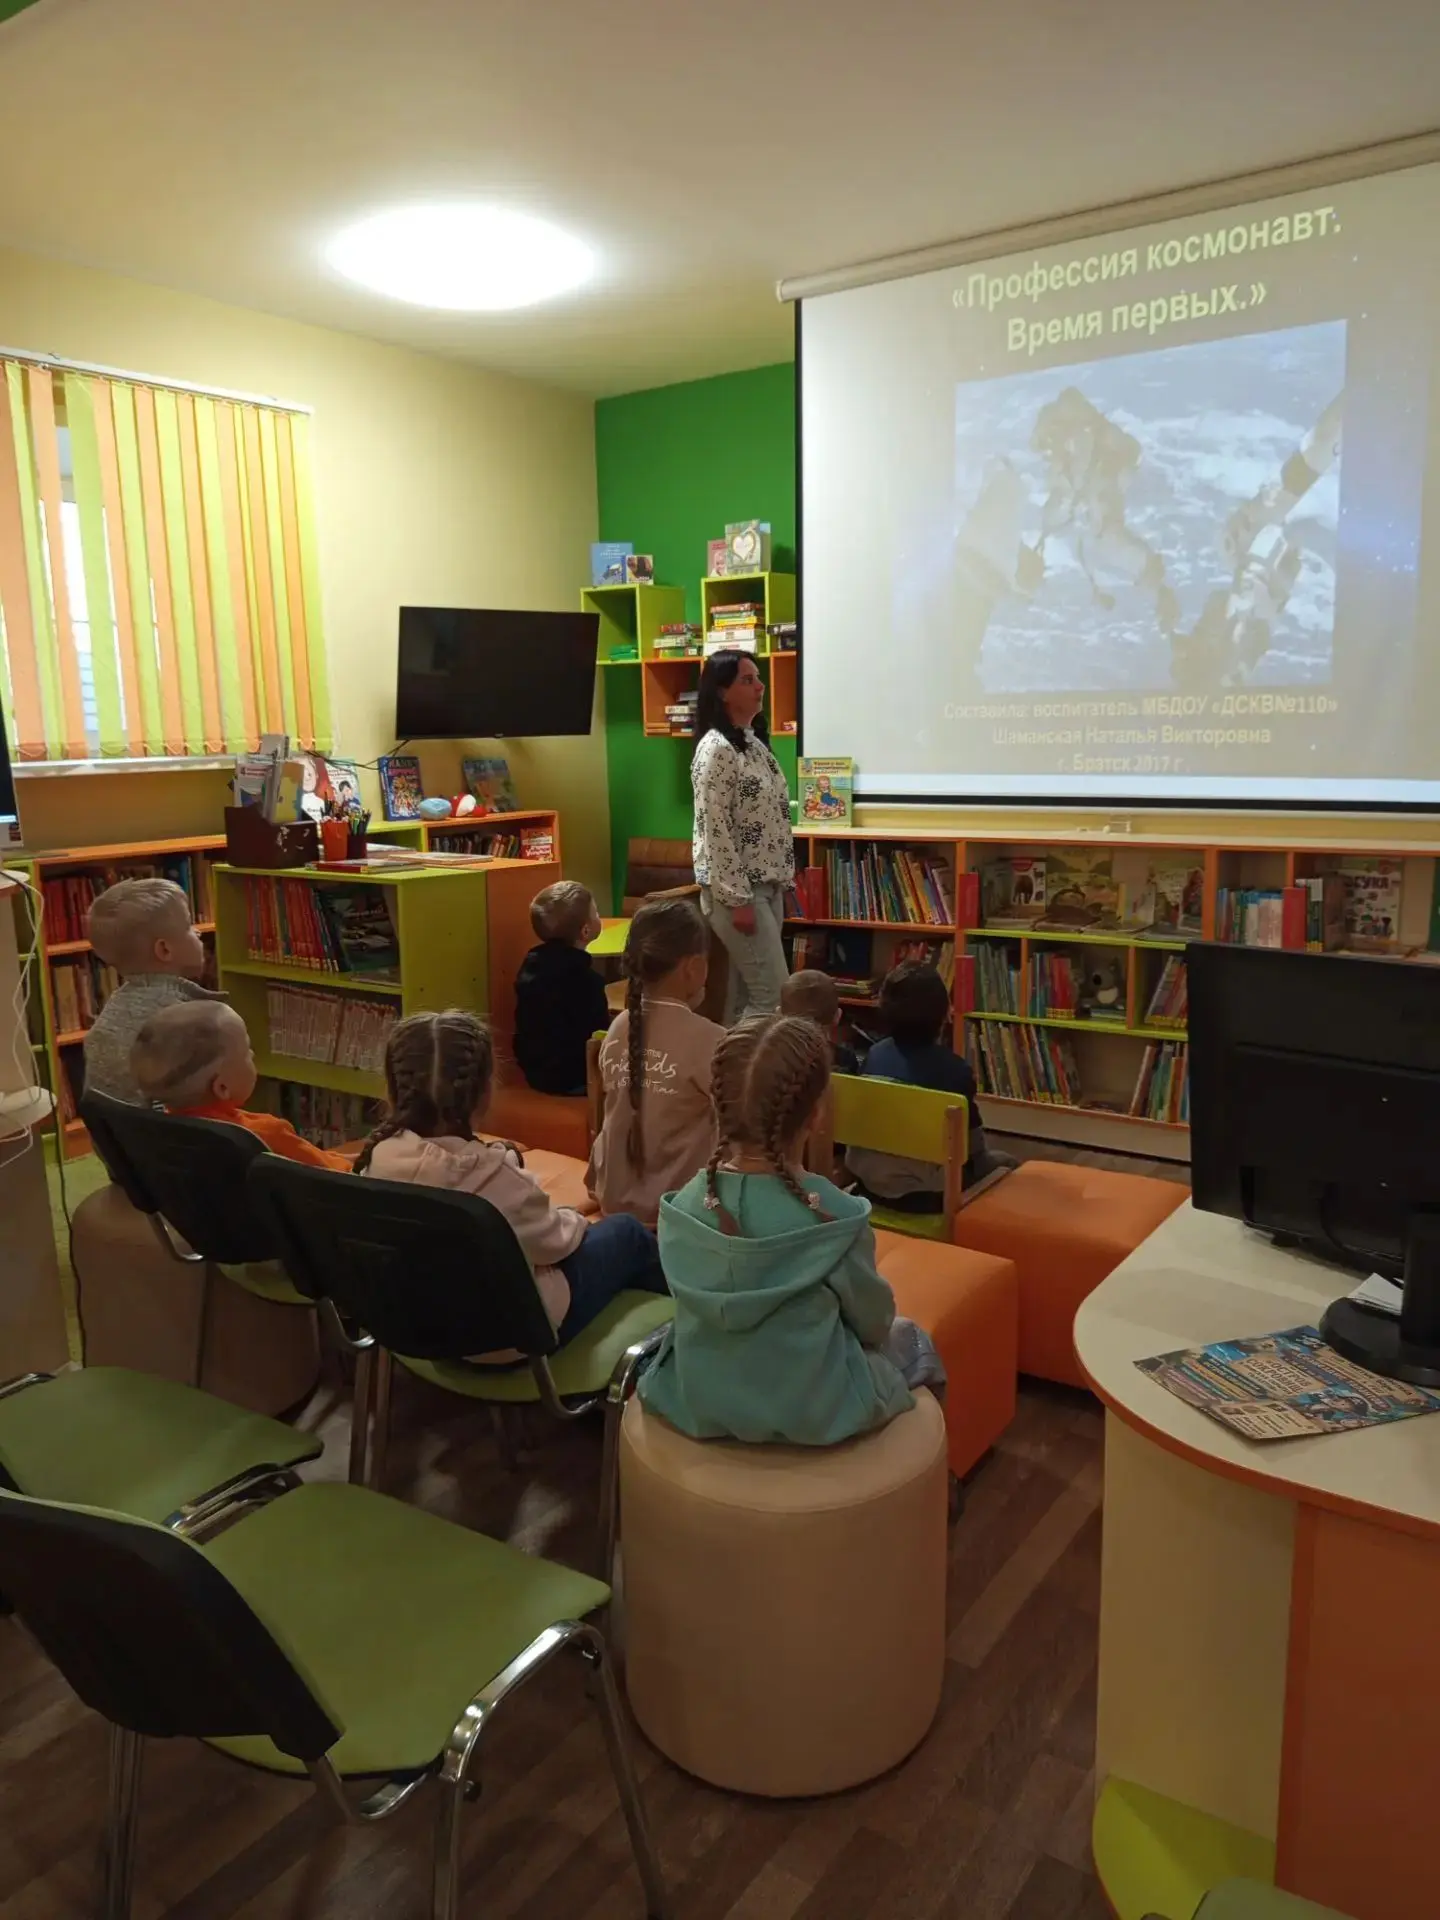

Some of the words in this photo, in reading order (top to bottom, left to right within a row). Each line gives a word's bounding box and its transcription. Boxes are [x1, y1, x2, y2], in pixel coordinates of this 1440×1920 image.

[952, 247, 1138, 311] «Профессия
[1147, 206, 1342, 272] космонавт.
[1008, 310, 1103, 356] Время
[1112, 282, 1267, 335] первых.»
[1033, 700, 1138, 718] воспитатель
[1141, 696, 1208, 718] МБДОУ
[992, 726, 1082, 745] Шаманская
[1085, 725, 1157, 745] Наталья
[1161, 724, 1272, 748] Викторовна
[1073, 752, 1130, 773] Братск
[1132, 756, 1170, 772] 2017
